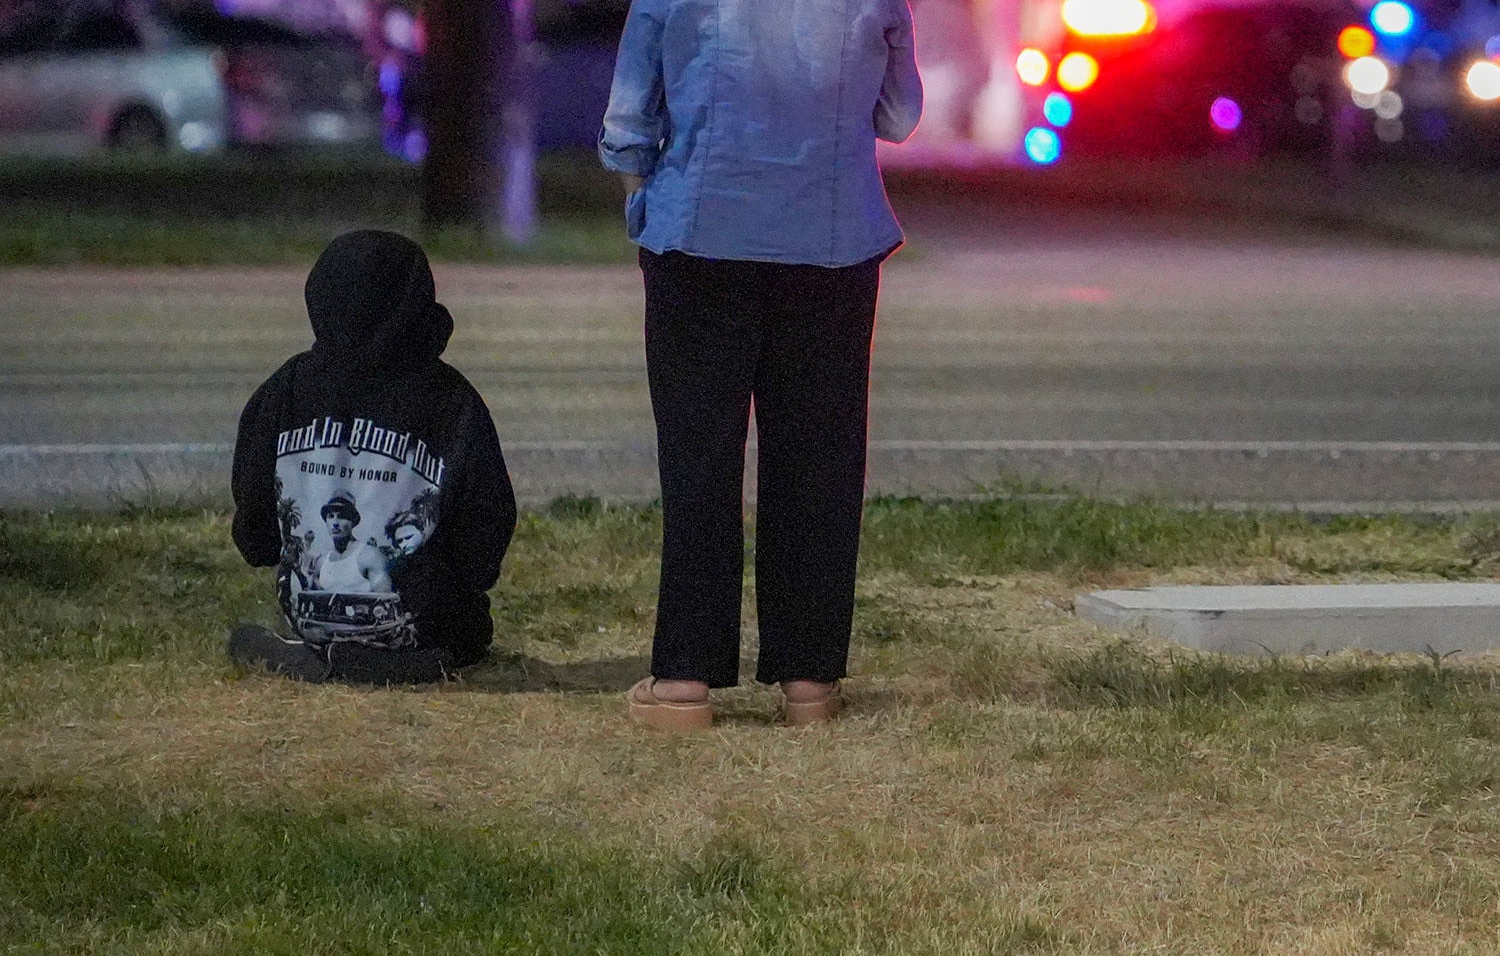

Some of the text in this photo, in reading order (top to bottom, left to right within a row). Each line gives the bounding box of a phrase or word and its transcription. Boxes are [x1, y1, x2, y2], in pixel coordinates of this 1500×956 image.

[277, 416, 446, 485] ood In Blood Out
[301, 461, 398, 483] BOUND BY HONOR
